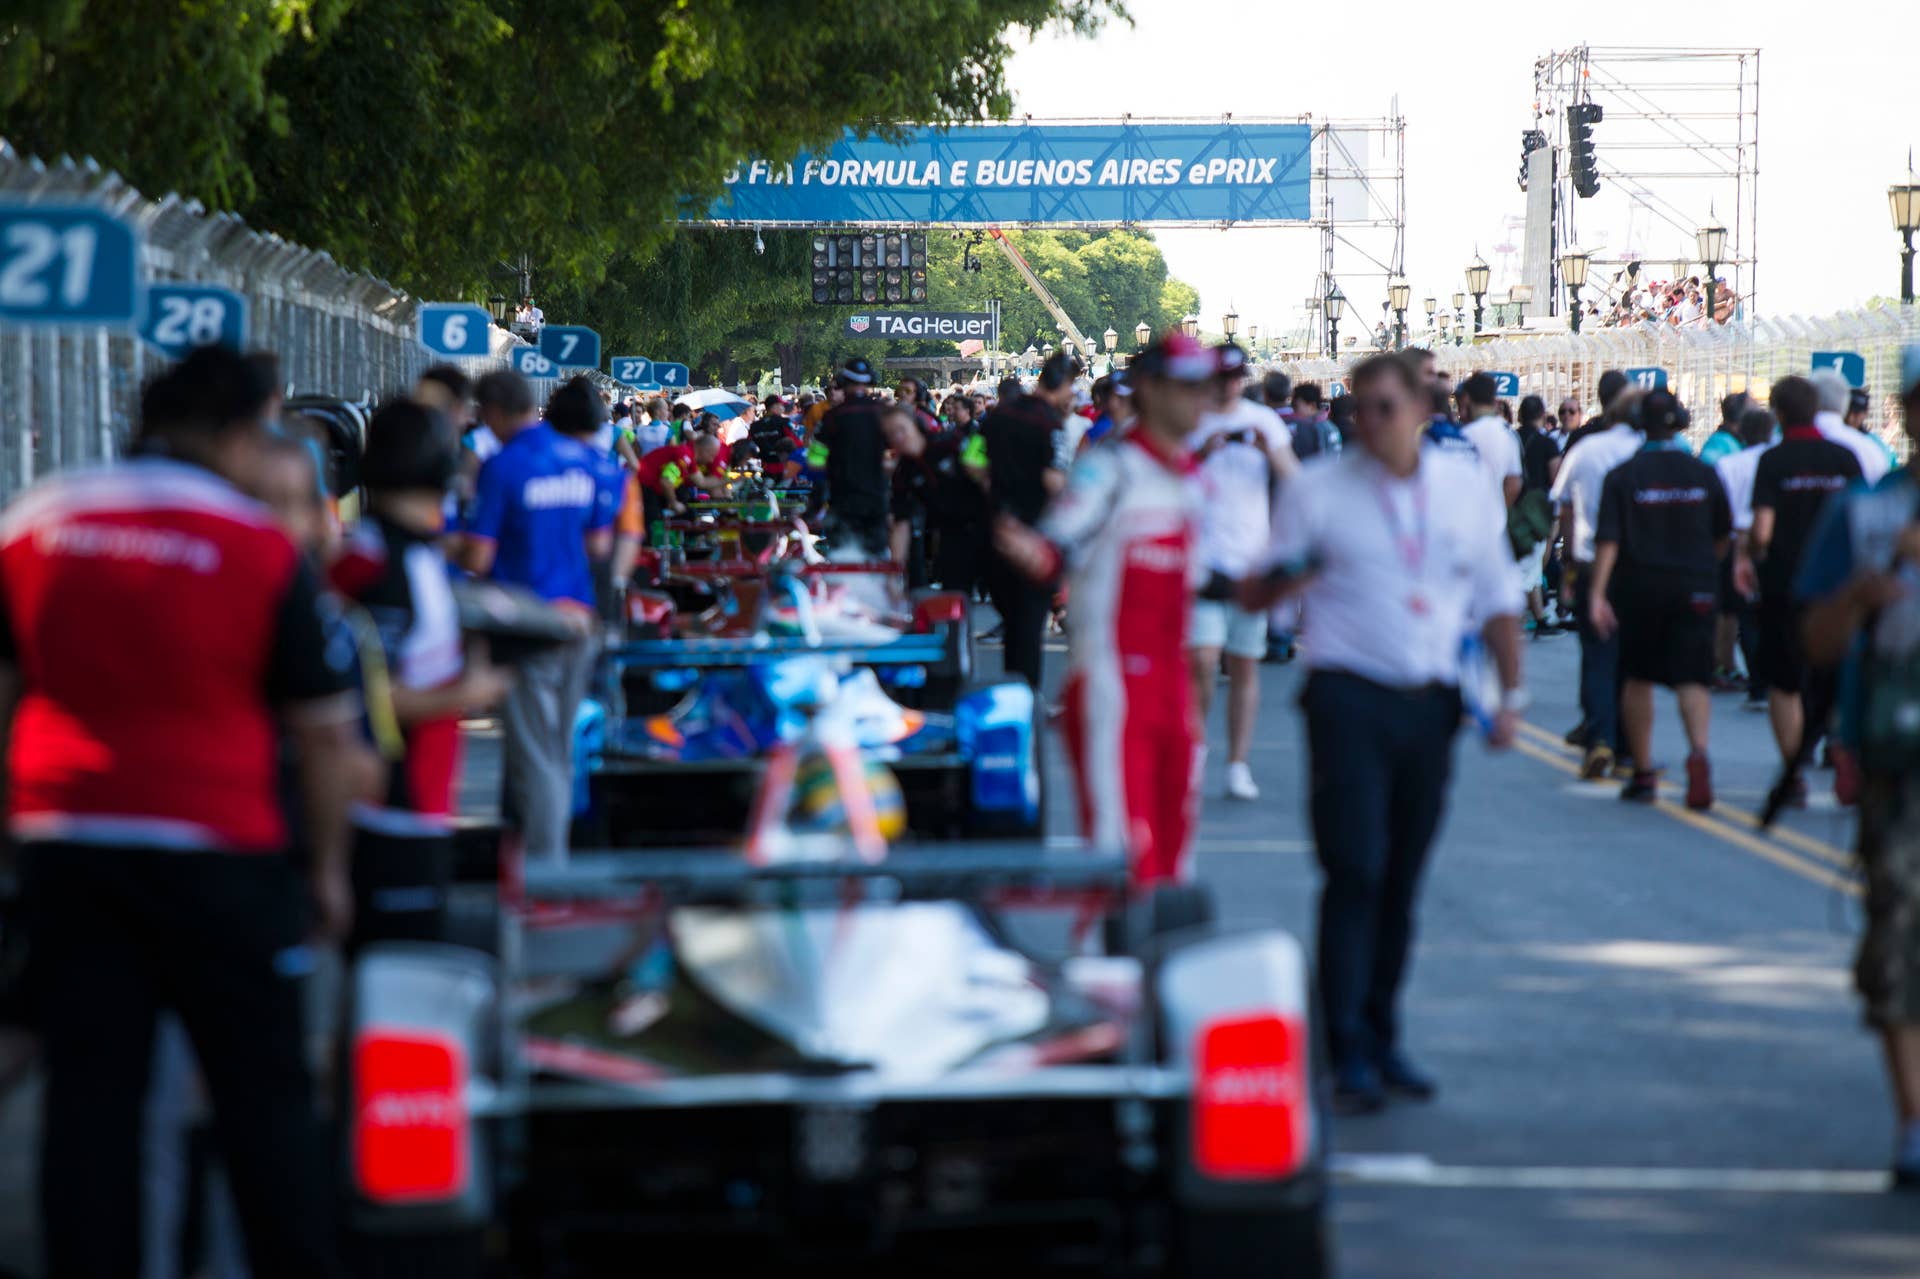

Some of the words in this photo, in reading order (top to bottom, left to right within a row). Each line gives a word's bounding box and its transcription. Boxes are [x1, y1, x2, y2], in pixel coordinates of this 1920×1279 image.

[803, 160, 941, 186] FORMULA
[950, 160, 968, 186] E
[976, 160, 1092, 186] BUENOS
[1099, 159, 1183, 185] AIRES
[1188, 158, 1278, 184] ePRIX
[0, 222, 97, 308] 21
[154, 295, 226, 346] 28
[442, 314, 468, 350] 6
[560, 334, 578, 359] 7
[621, 362, 646, 380] 27
[664, 368, 676, 383] 4
